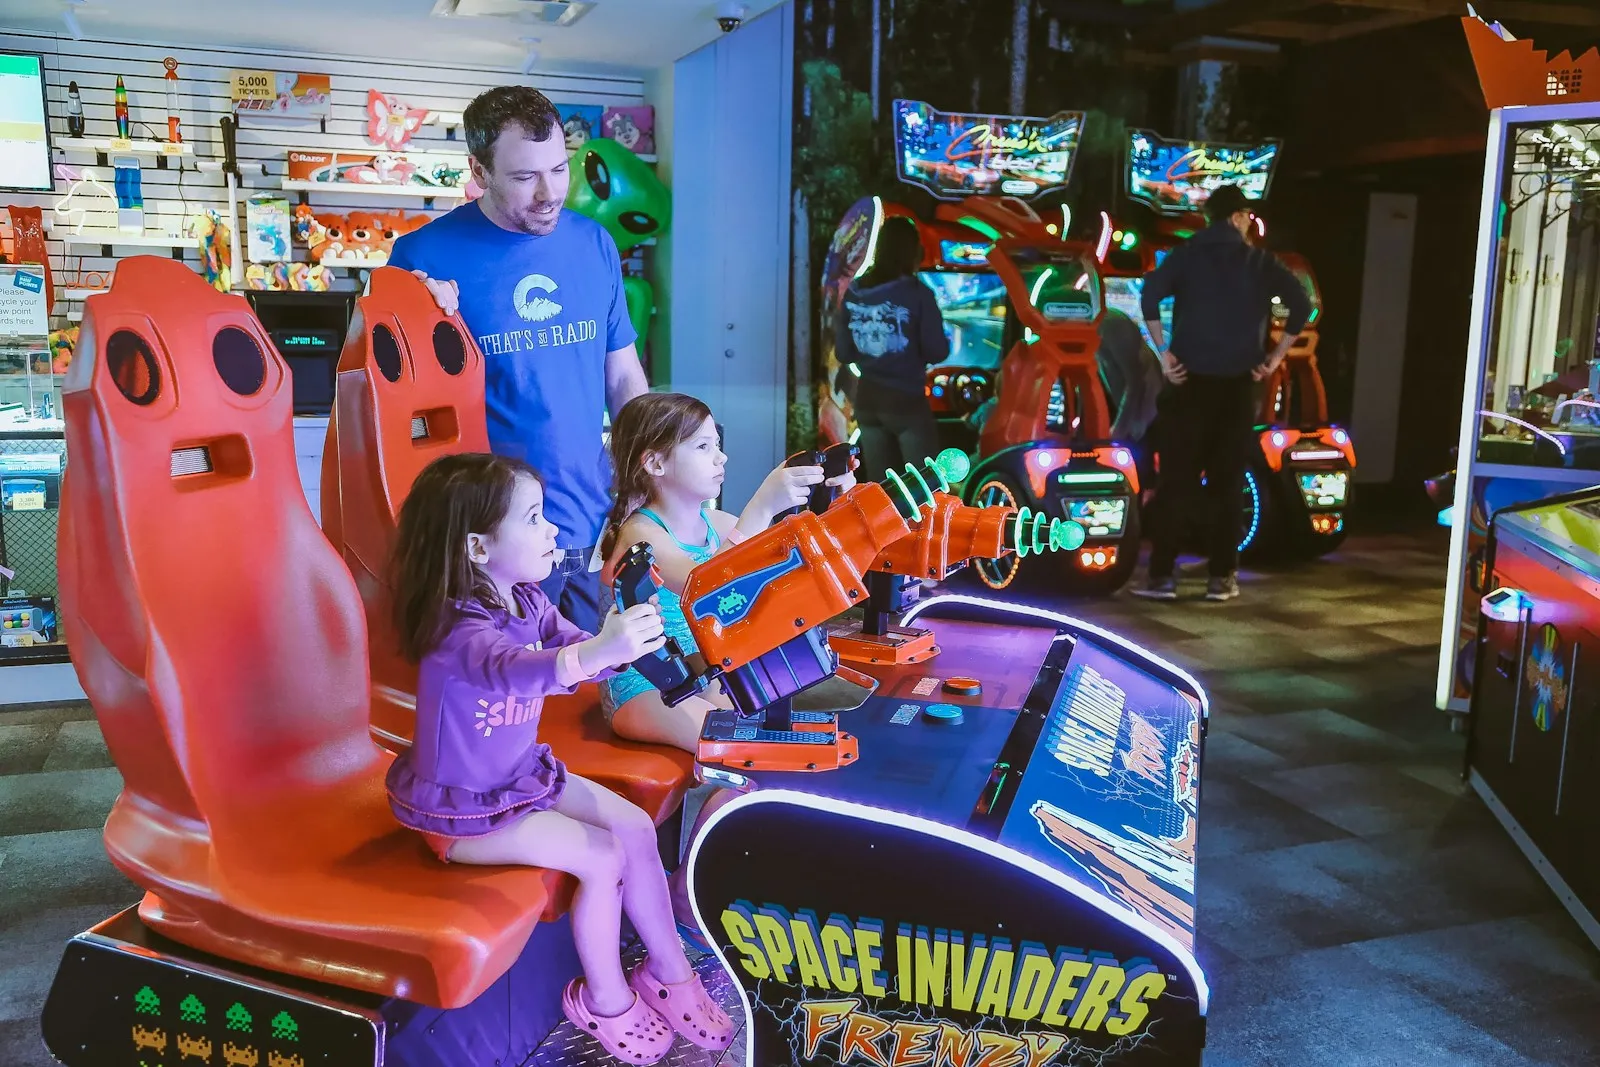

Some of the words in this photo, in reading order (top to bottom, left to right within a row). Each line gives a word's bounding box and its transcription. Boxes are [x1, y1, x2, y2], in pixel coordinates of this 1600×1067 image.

[238, 76, 268, 87] 5,000
[238, 88, 270, 96] TICKETS
[299, 154, 327, 163] Razor
[12, 308, 31, 316] point
[16, 317, 34, 325] here
[478, 329, 534, 356] THAT'S
[550, 319, 597, 347] RADO
[720, 902, 888, 1000] SPACE
[895, 926, 1166, 1037] INVADERS
[800, 998, 1067, 1067] FRENZY
